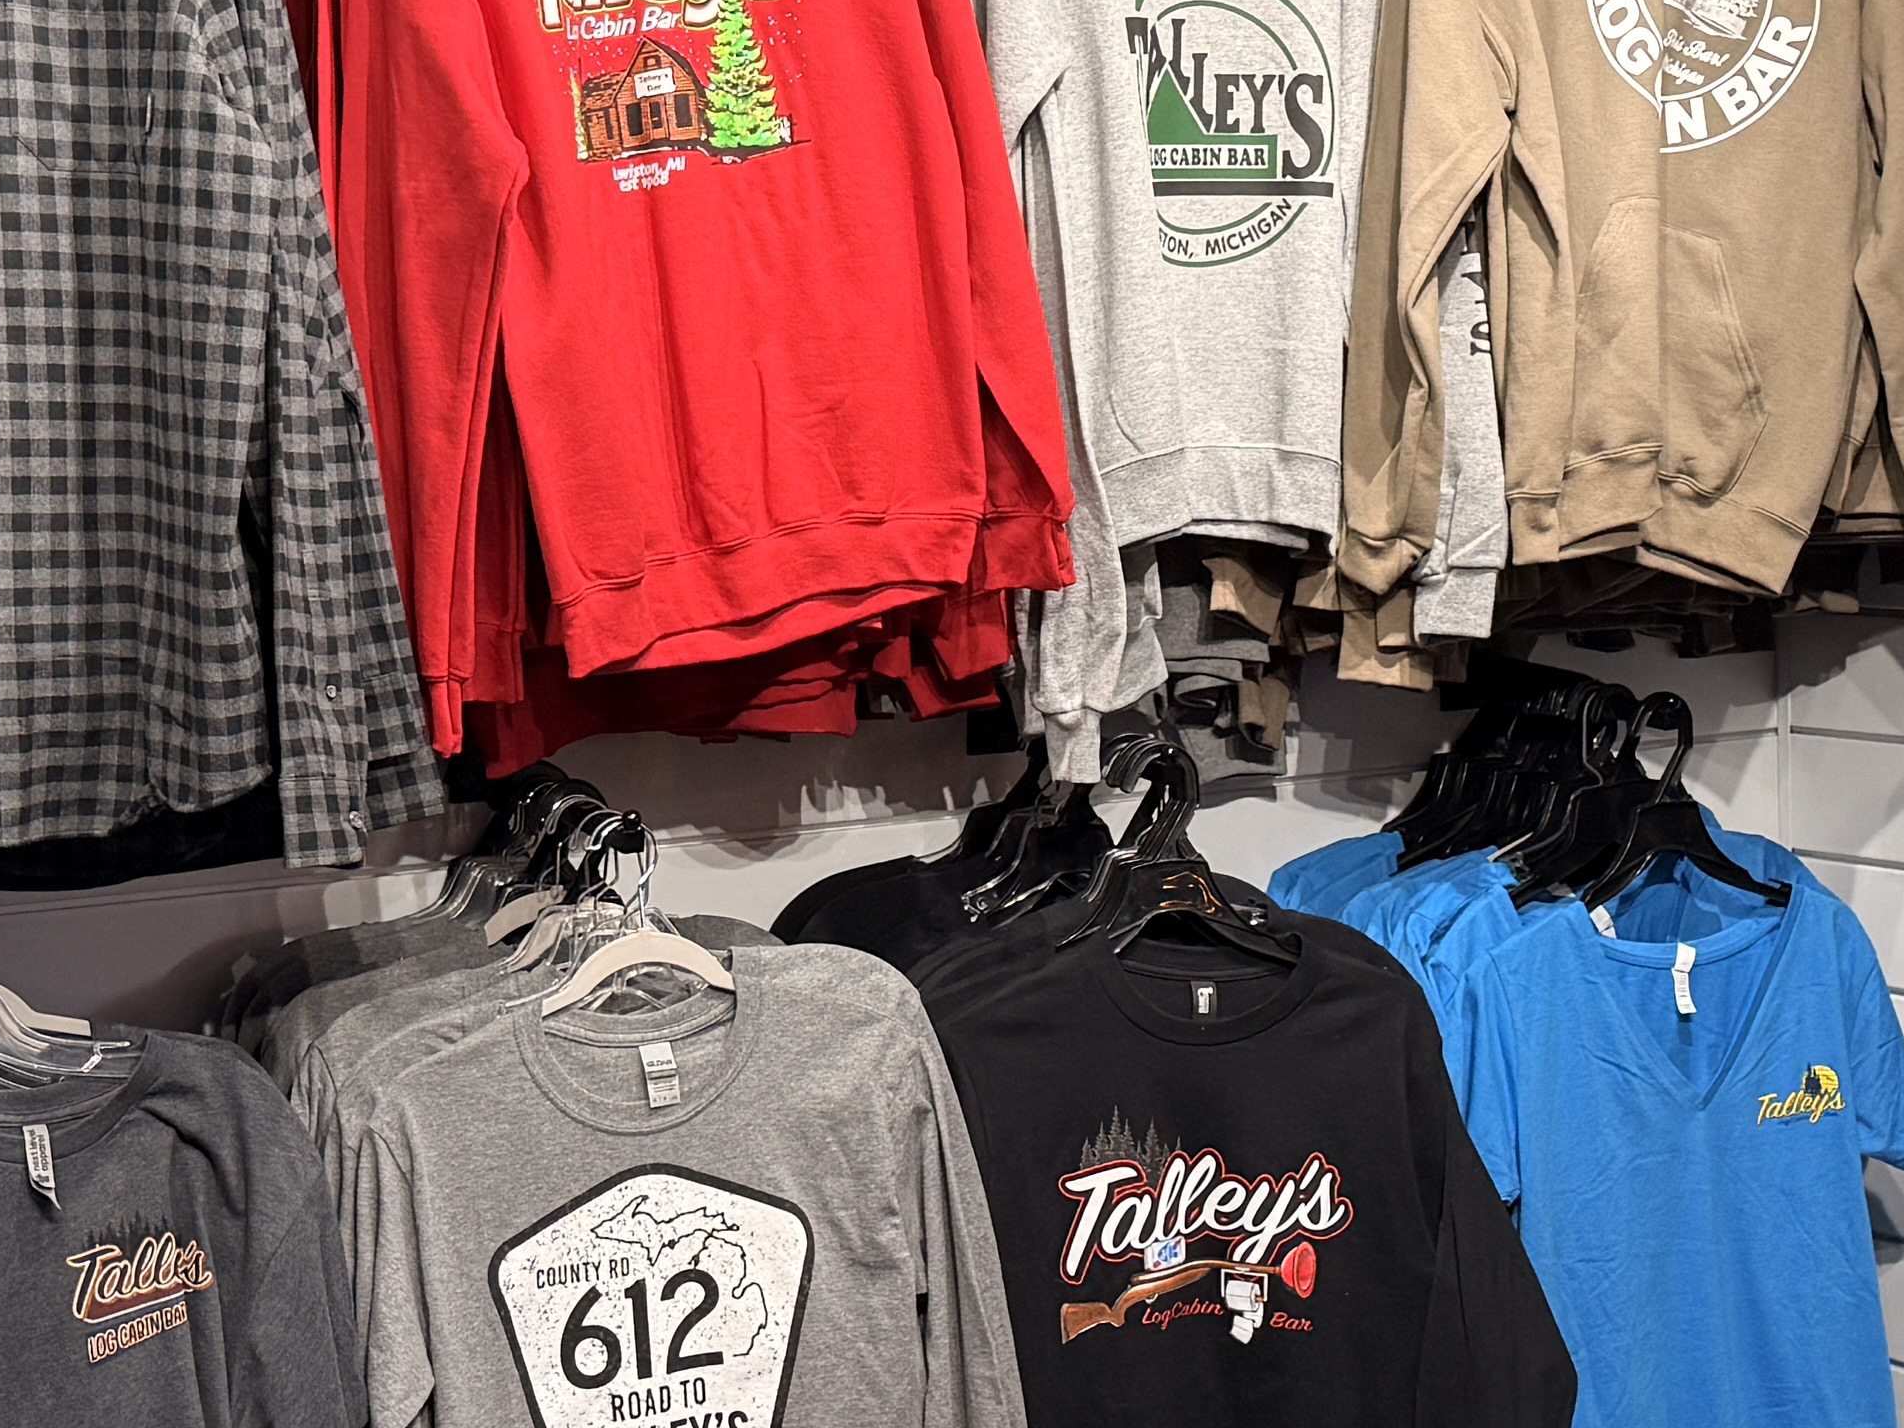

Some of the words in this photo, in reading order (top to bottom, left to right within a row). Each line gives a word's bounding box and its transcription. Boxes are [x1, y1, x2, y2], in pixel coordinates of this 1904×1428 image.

[581, 12, 636, 40] Cabin
[640, 5, 682, 32] Bar
[1723, 15, 1813, 127] BAR
[1125, 16, 1325, 180] TALLEY'S
[1170, 147, 1223, 166] CABIN
[1227, 147, 1267, 166] BAR
[1204, 198, 1293, 257] MICHIGAN
[1756, 1088, 1846, 1126] Talley's
[1061, 1150, 1350, 1282] Talley's
[535, 1258, 602, 1289] COUNTY
[606, 1257, 631, 1279] RD
[87, 1328, 117, 1364] LOG
[117, 1310, 163, 1349] CABIN
[559, 1268, 725, 1391] 612
[1141, 1306, 1172, 1331] Log
[1171, 1298, 1226, 1318] Cabin
[1269, 1311, 1314, 1332] Bar
[610, 1383, 672, 1423] ROAD
[679, 1375, 708, 1405] TO
